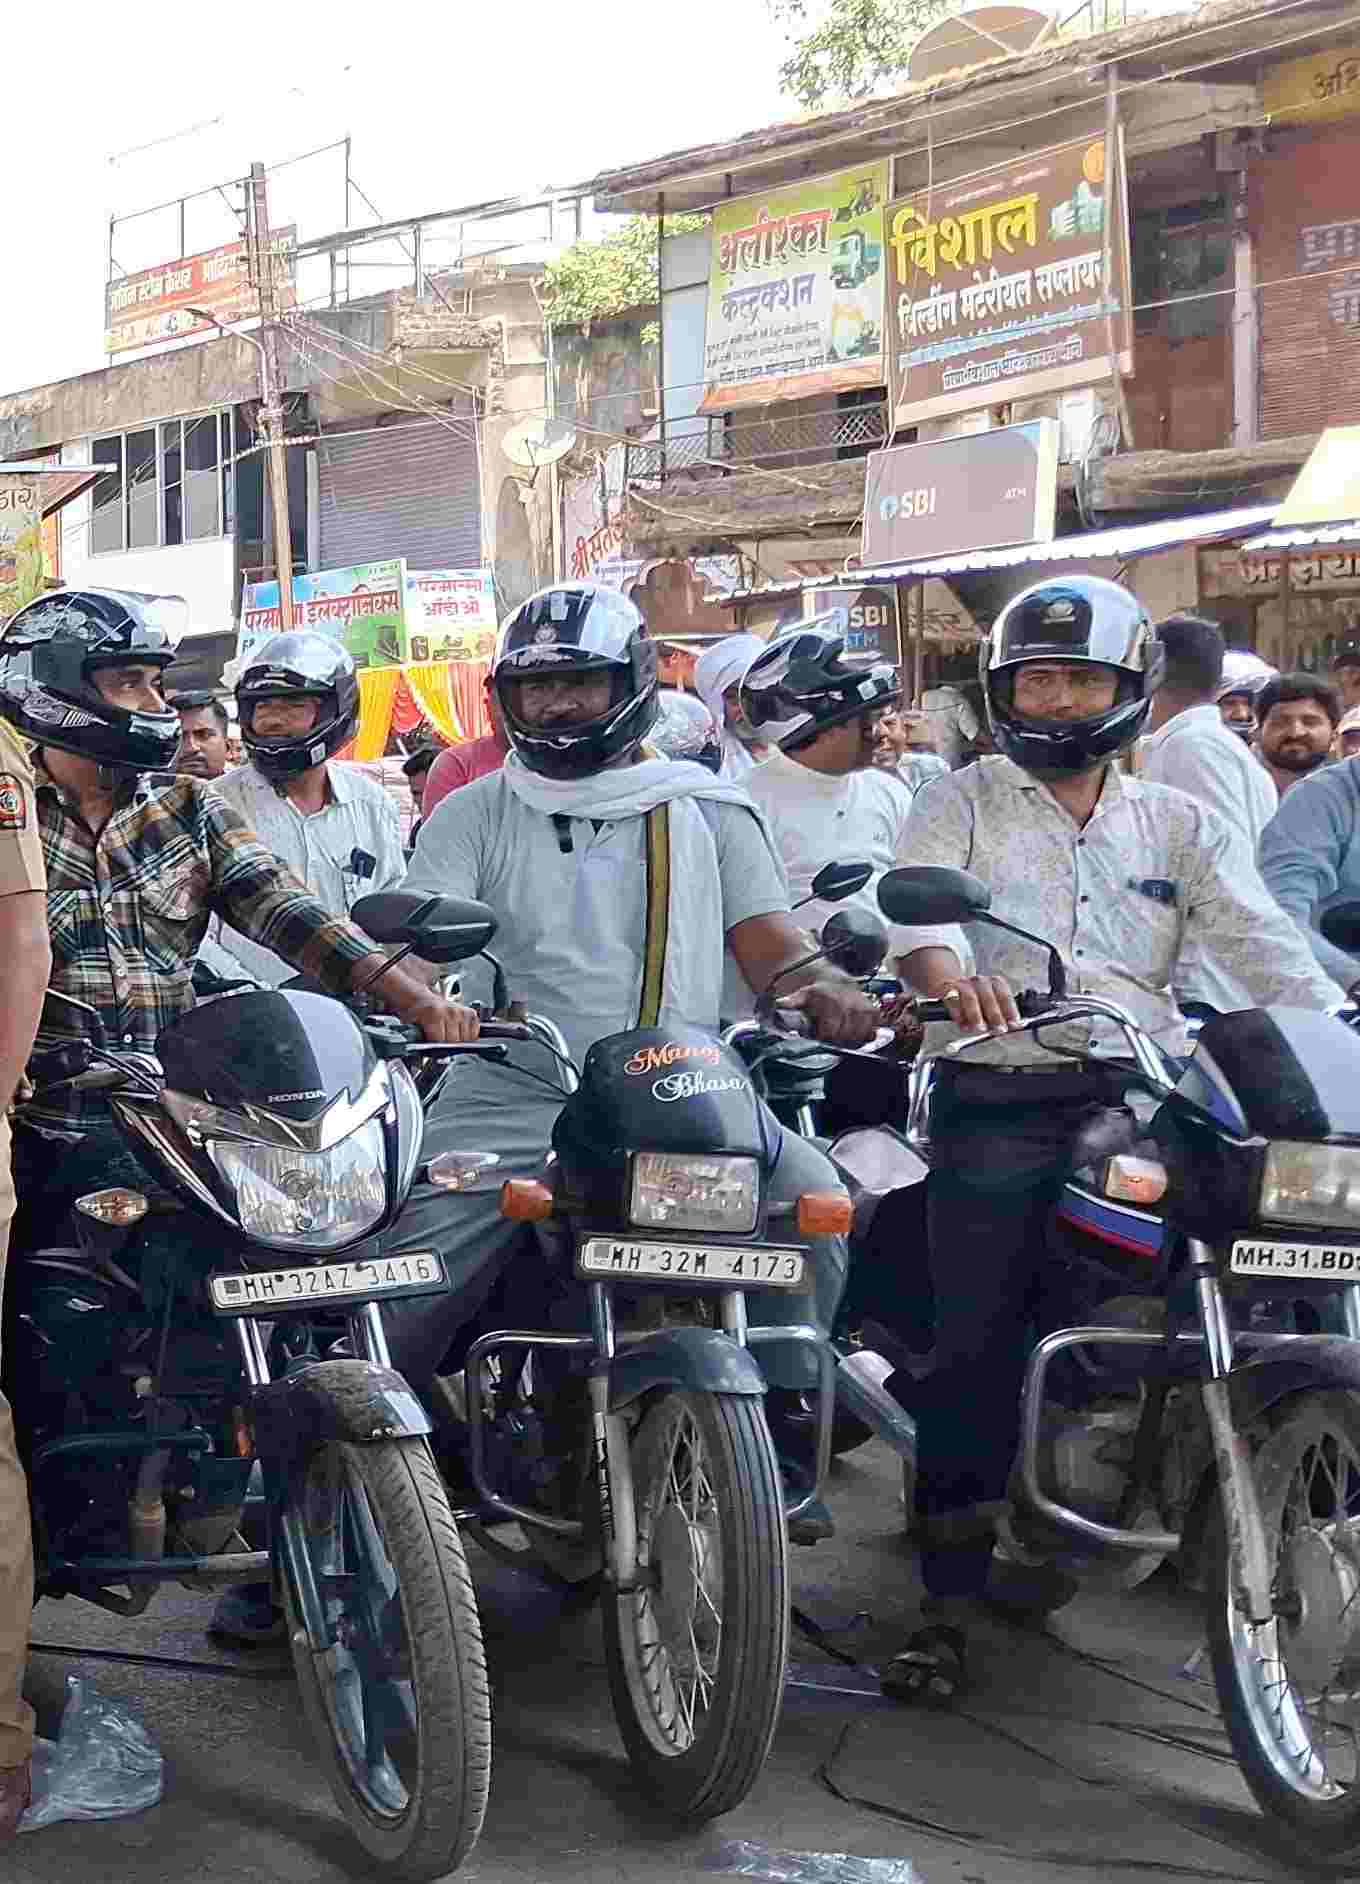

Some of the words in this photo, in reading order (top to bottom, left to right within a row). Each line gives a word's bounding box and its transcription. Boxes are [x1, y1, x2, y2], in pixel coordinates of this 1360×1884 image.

[889, 192, 1040, 285] विशाल
[900, 487, 937, 518] SBI
[849, 605, 888, 628] SBI
[610, 1247, 641, 1269] MH
[730, 1254, 796, 1279] 4173
[1236, 1247, 1360, 1270] MH.31.BD
[244, 1277, 275, 1300] MH
[289, 1267, 352, 1294] 32AZ
[367, 1258, 430, 1286] 3416
